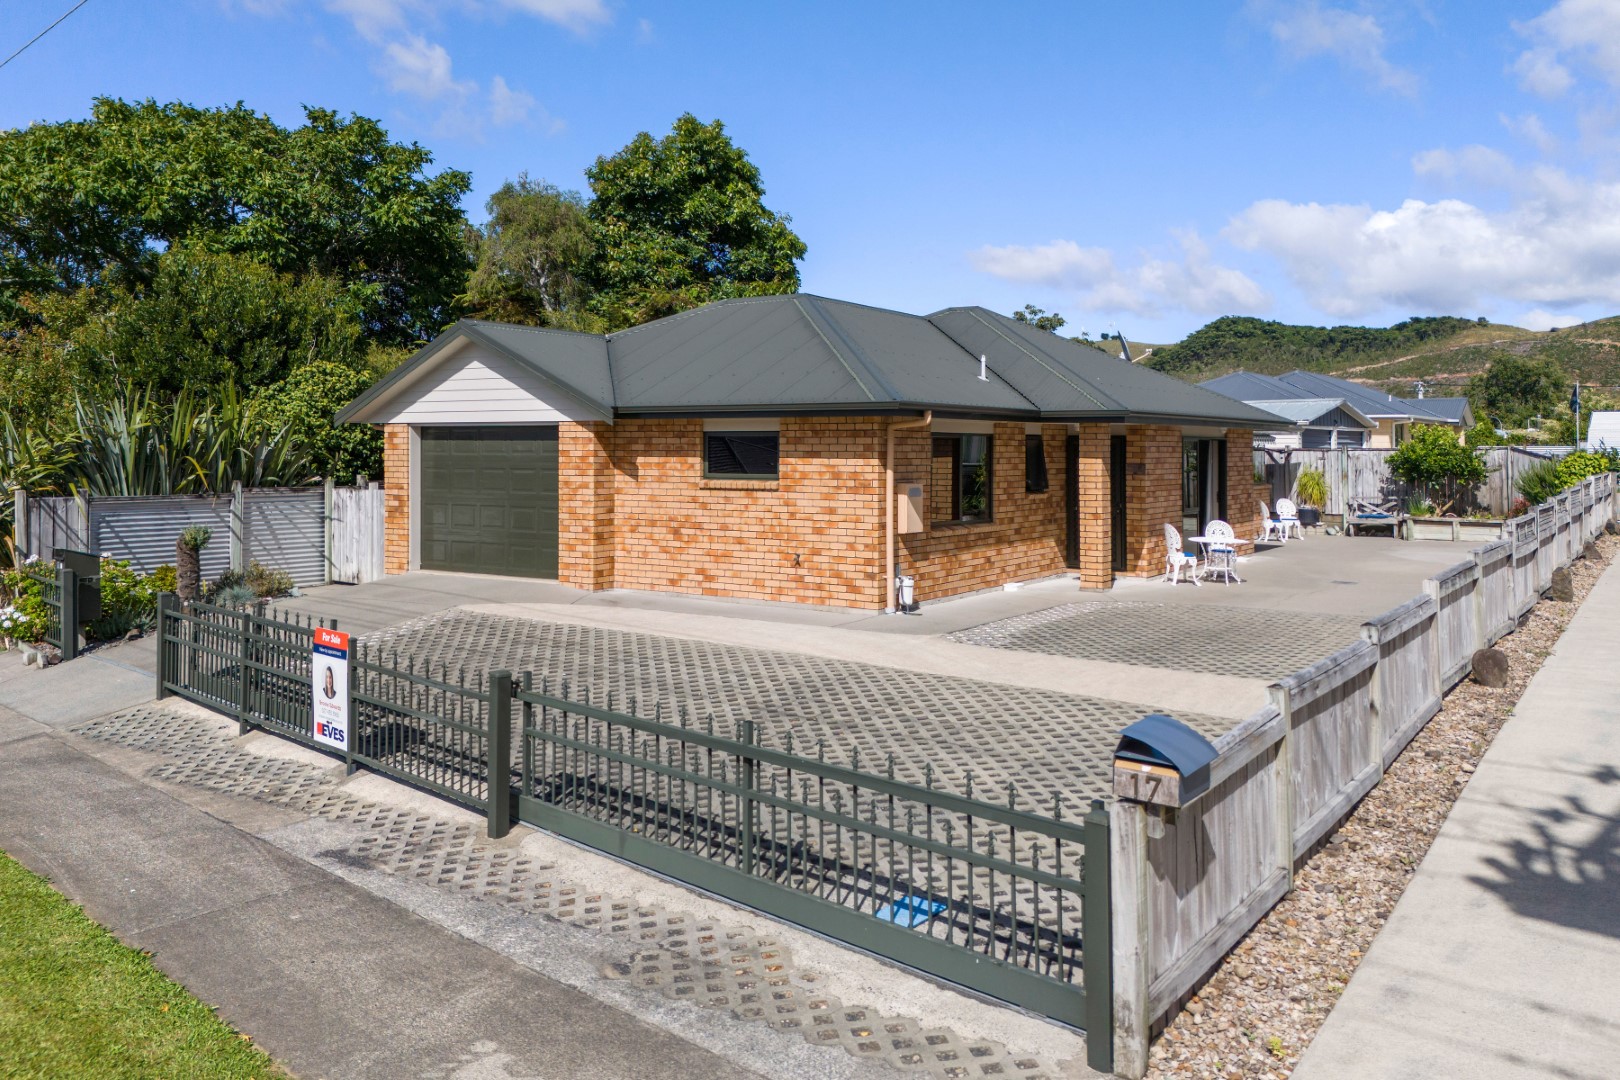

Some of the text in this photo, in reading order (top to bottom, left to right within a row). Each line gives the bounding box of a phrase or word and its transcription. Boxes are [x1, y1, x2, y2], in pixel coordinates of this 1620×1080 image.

[322, 632, 341, 645] For Sale
[321, 723, 345, 742] EVES
[1130, 773, 1162, 802] 17
